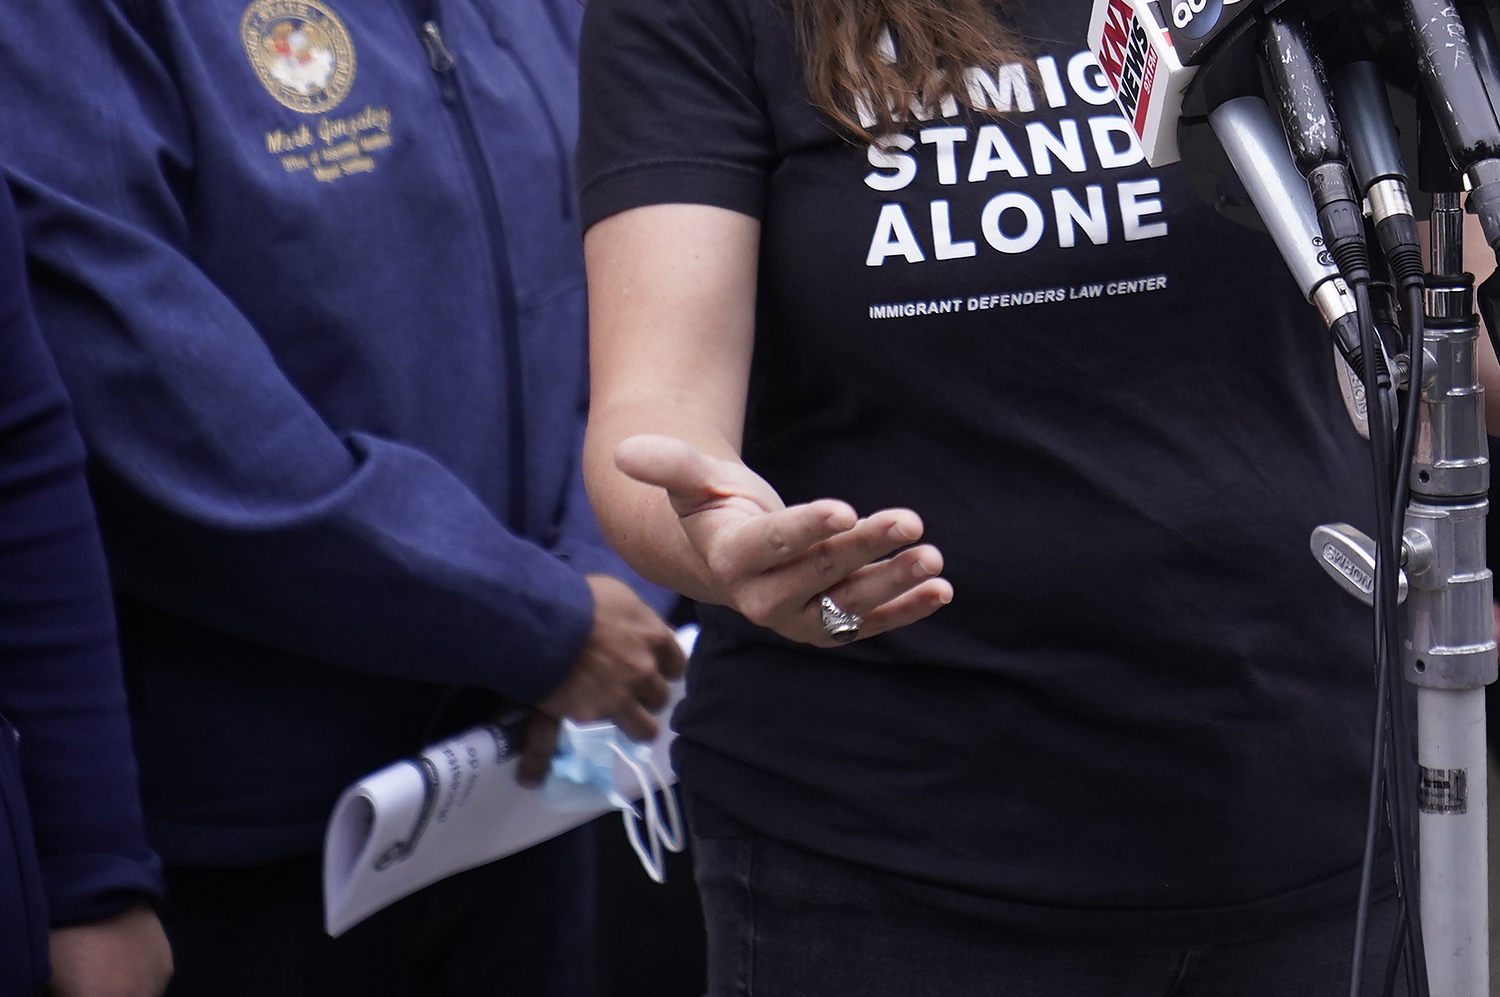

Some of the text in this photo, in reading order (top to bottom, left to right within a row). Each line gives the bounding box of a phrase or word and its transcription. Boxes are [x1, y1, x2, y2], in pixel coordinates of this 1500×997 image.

[1118, 15, 1148, 123] NEWS
[864, 115, 1145, 191] STAND
[866, 178, 1168, 266] ALONE
[869, 275, 1168, 319] IMMIGRANT DEFENDERS LAW CENTER
[1324, 545, 1374, 593] NORMS
